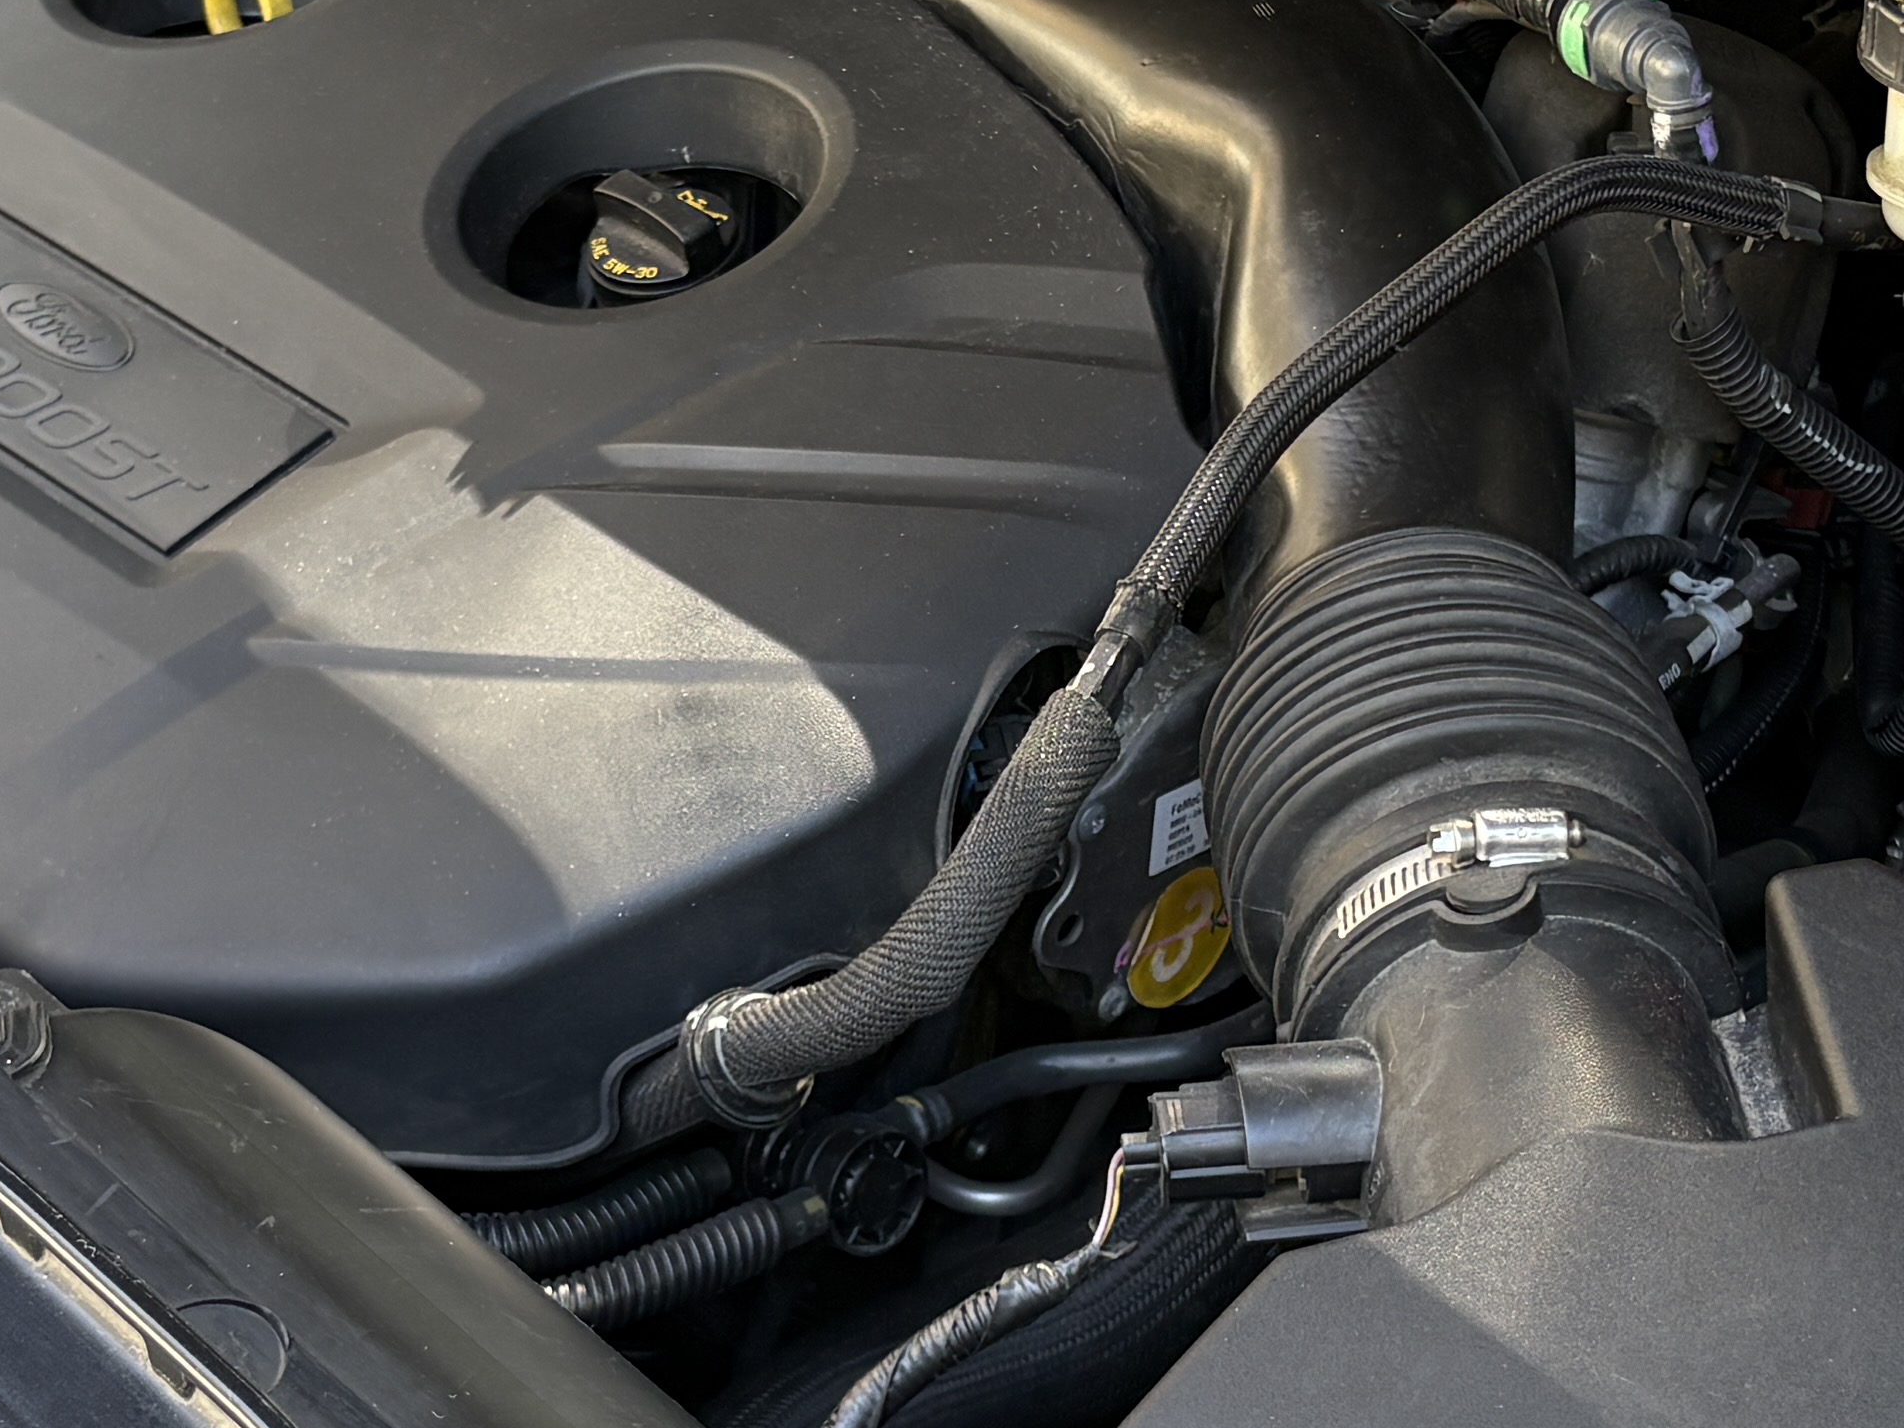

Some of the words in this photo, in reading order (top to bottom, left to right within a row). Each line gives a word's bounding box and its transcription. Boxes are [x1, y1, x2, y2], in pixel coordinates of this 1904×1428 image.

[589, 236, 610, 262] SAE
[602, 256, 659, 280] 5W-30
[11, 289, 93, 357] Ford
